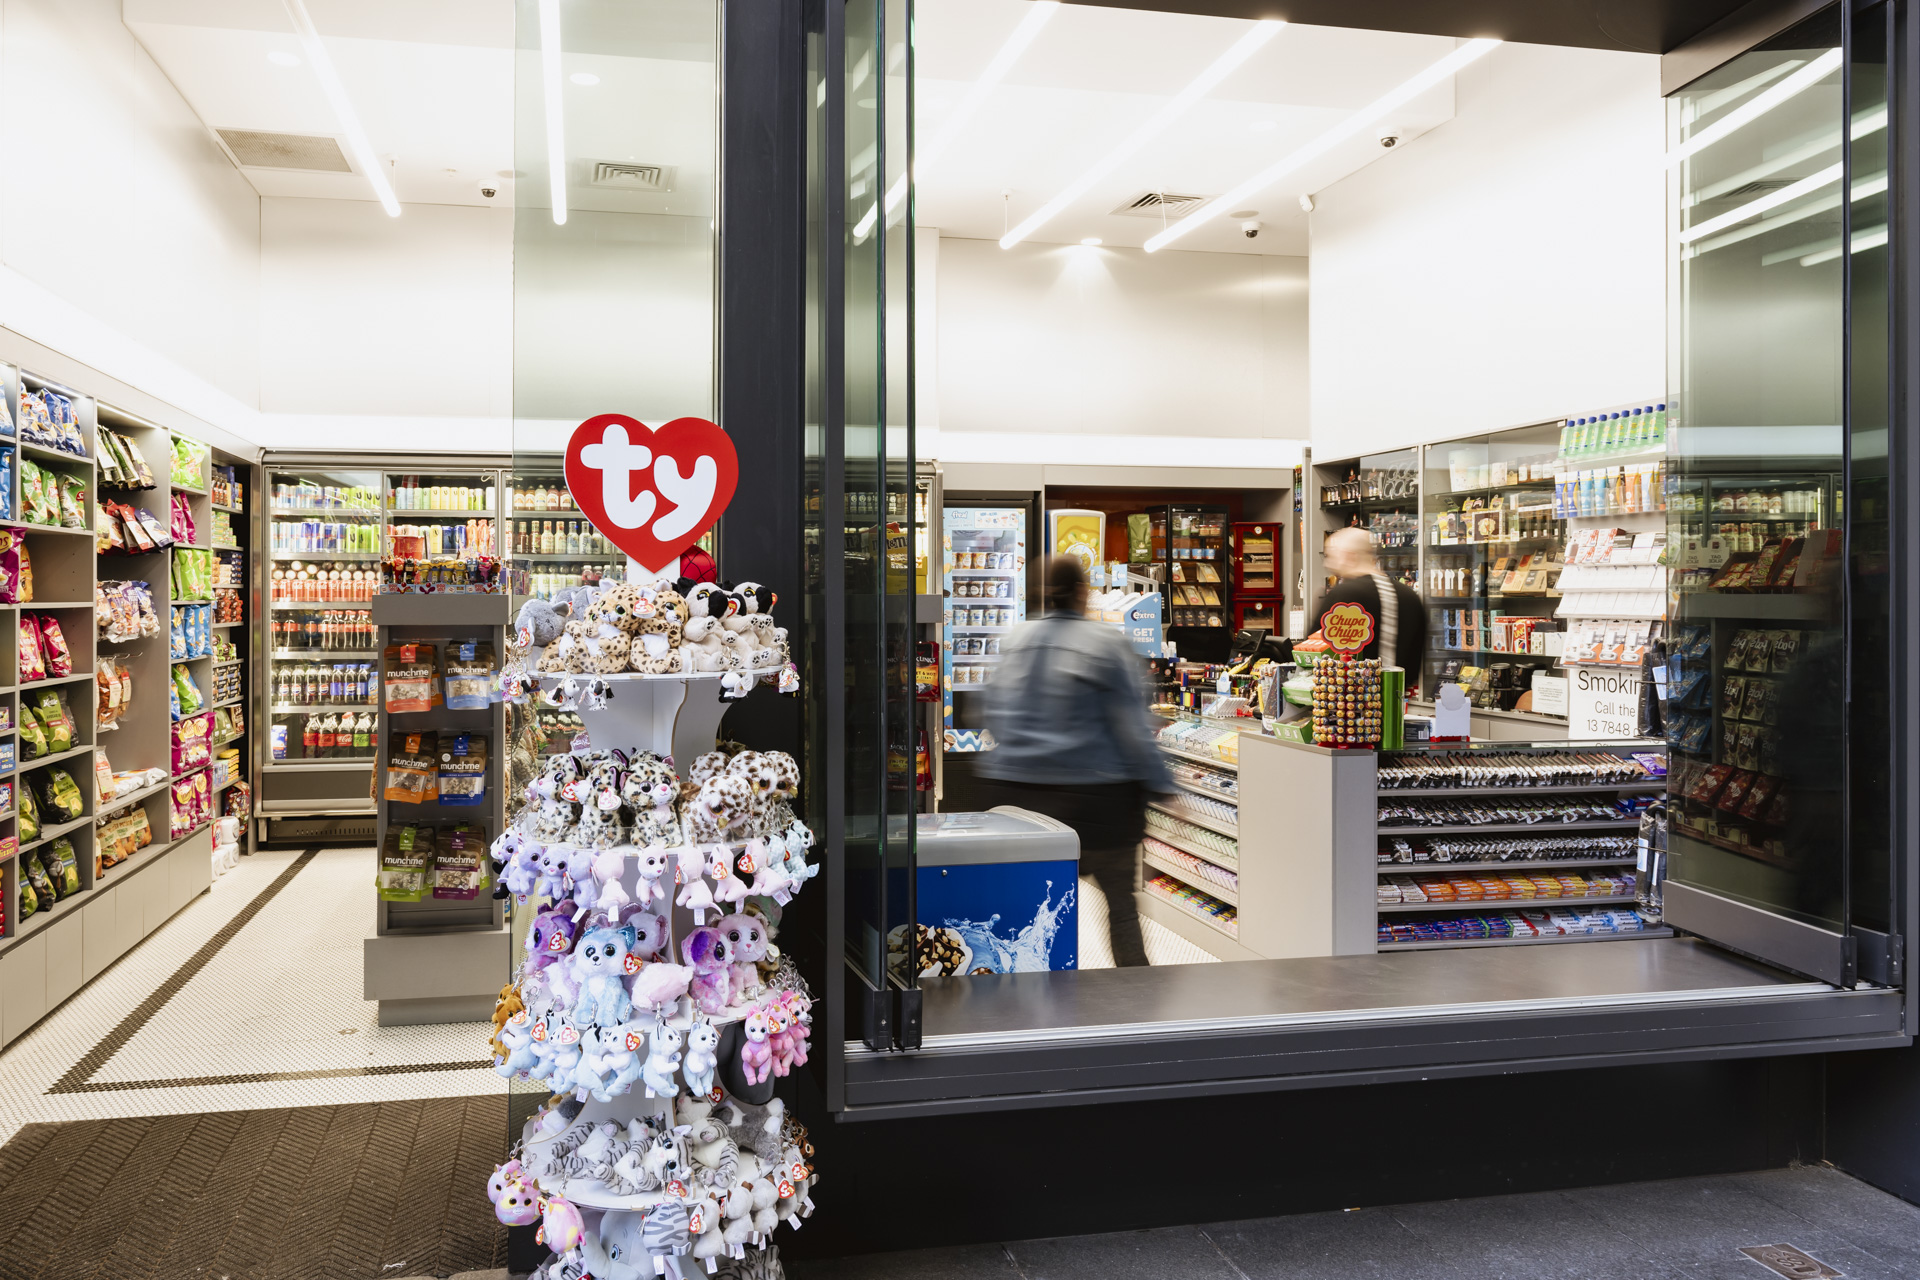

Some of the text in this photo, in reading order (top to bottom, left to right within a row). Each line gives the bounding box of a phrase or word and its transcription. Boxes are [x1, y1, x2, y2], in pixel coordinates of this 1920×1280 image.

[580, 424, 717, 541] ty
[1133, 611, 1155, 619] extra
[1330, 615, 1366, 629] Chupa
[1133, 628, 1154, 636] GET
[1327, 626, 1364, 642] Chups
[387, 668, 429, 678] munchme
[447, 665, 488, 674] munchme
[1595, 701, 1636, 717] Call the
[1587, 719, 1598, 732] 13
[1601, 720, 1631, 736] 7848
[391, 758, 428, 768] munchme
[440, 761, 480, 770] munchme
[384, 856, 424, 865] munchme
[437, 855, 476, 864] munchme
[551, 934, 561, 949] ty
[626, 957, 638, 973] ty
[533, 1024, 544, 1038] ty
[627, 1035, 637, 1050] ty
[794, 1166, 803, 1179] ty
[780, 1184, 790, 1197] ty
